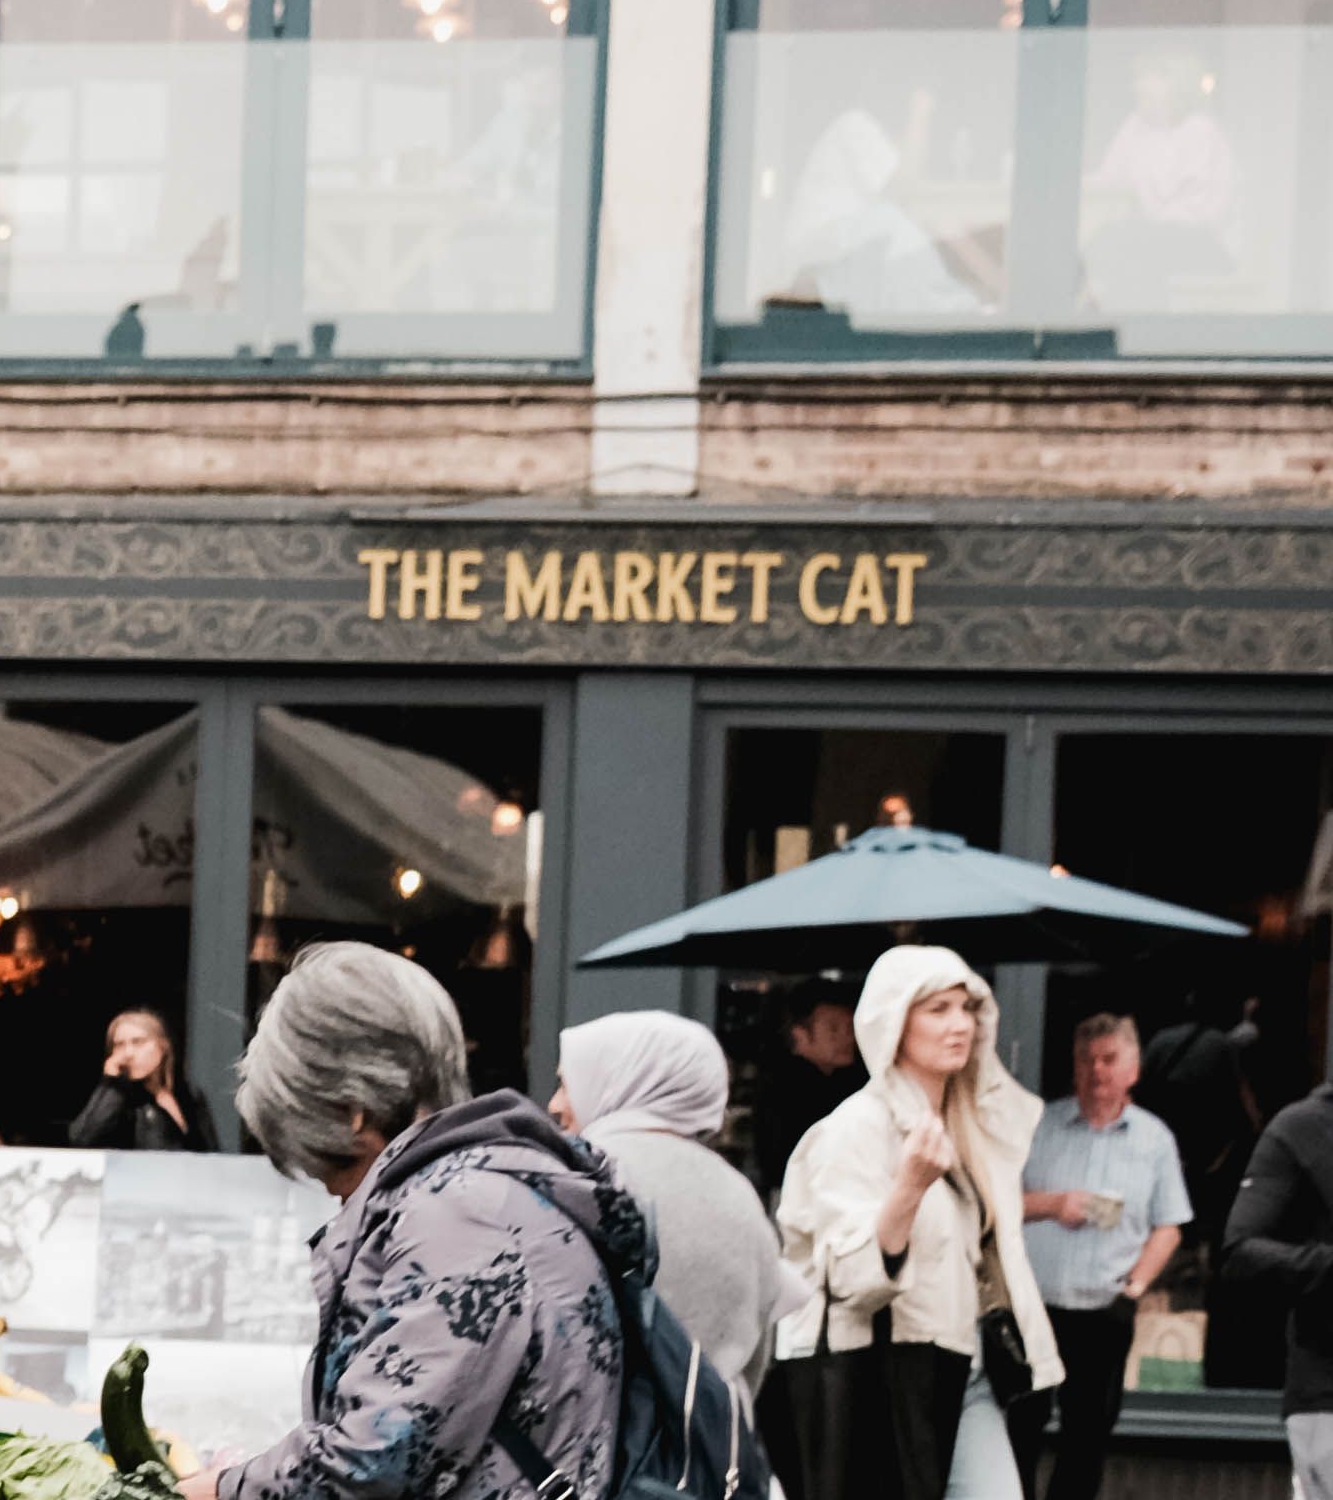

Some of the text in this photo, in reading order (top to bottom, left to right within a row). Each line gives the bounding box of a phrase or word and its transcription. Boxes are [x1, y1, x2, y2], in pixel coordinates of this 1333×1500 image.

[357, 549, 928, 626] THE MARKET CAT
